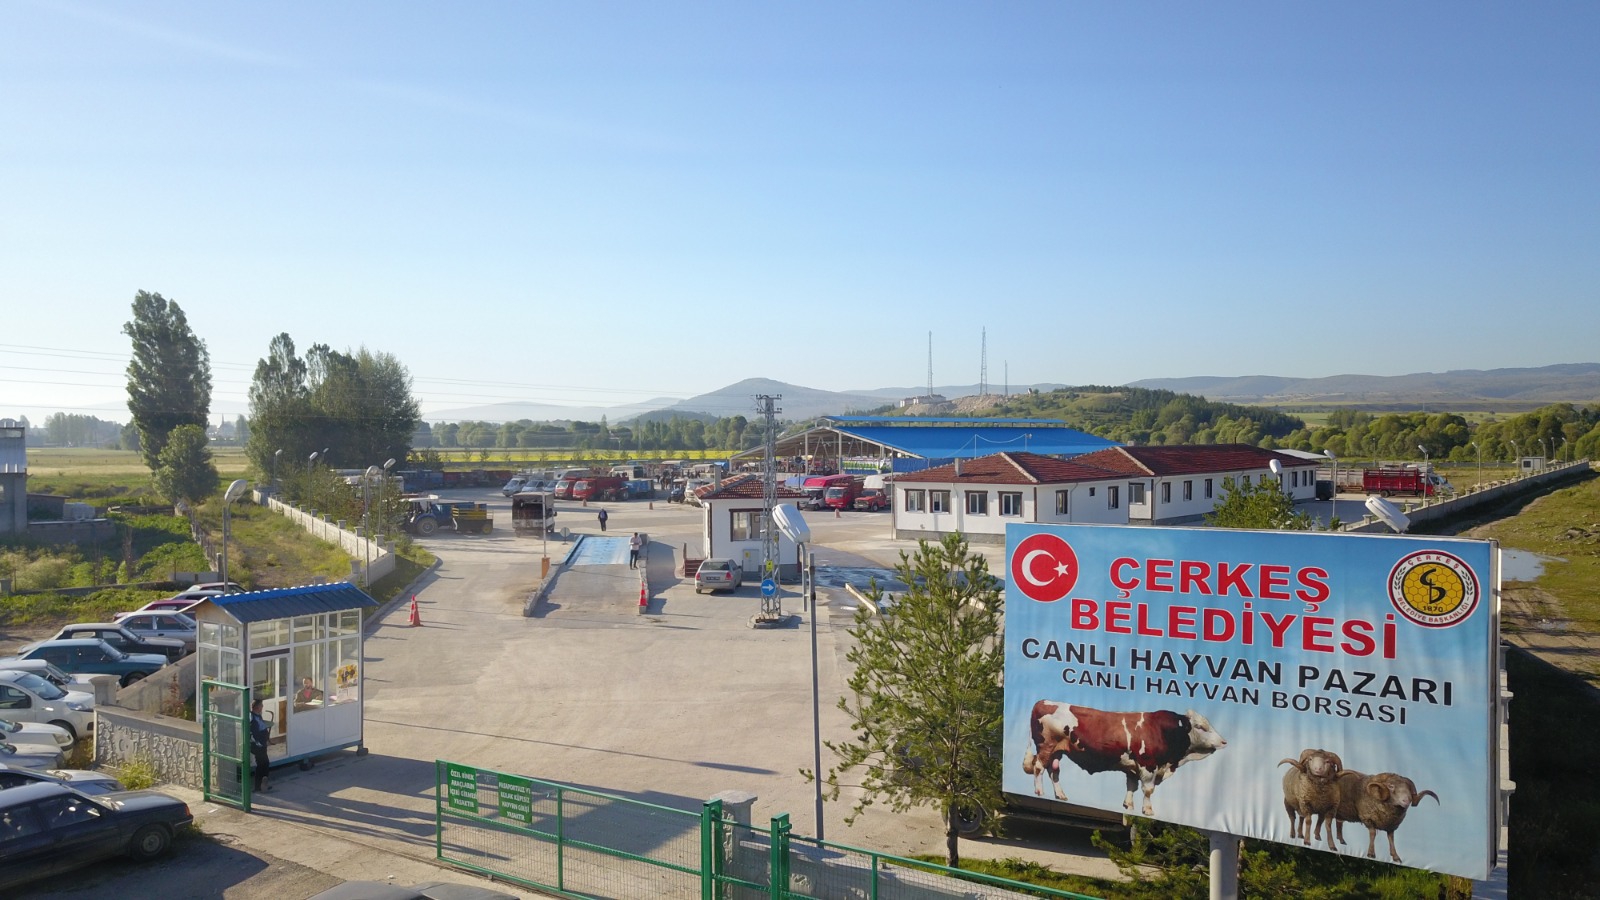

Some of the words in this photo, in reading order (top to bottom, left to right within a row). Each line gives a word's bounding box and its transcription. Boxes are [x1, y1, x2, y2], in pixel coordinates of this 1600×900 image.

[1109, 557, 1331, 613] ÇERKEŞ
[1408, 555, 1460, 570] ÇERKEŞ
[1071, 597, 1396, 659] BELEDİYESİ
[1022, 638, 1117, 668] CANLI
[1130, 647, 1281, 685] HAYVAN
[1298, 664, 1453, 706] PAZARI
[1062, 668, 1134, 690] CANLI
[1146, 676, 1259, 705] HAYVAN
[1272, 691, 1406, 726] BORSASI
